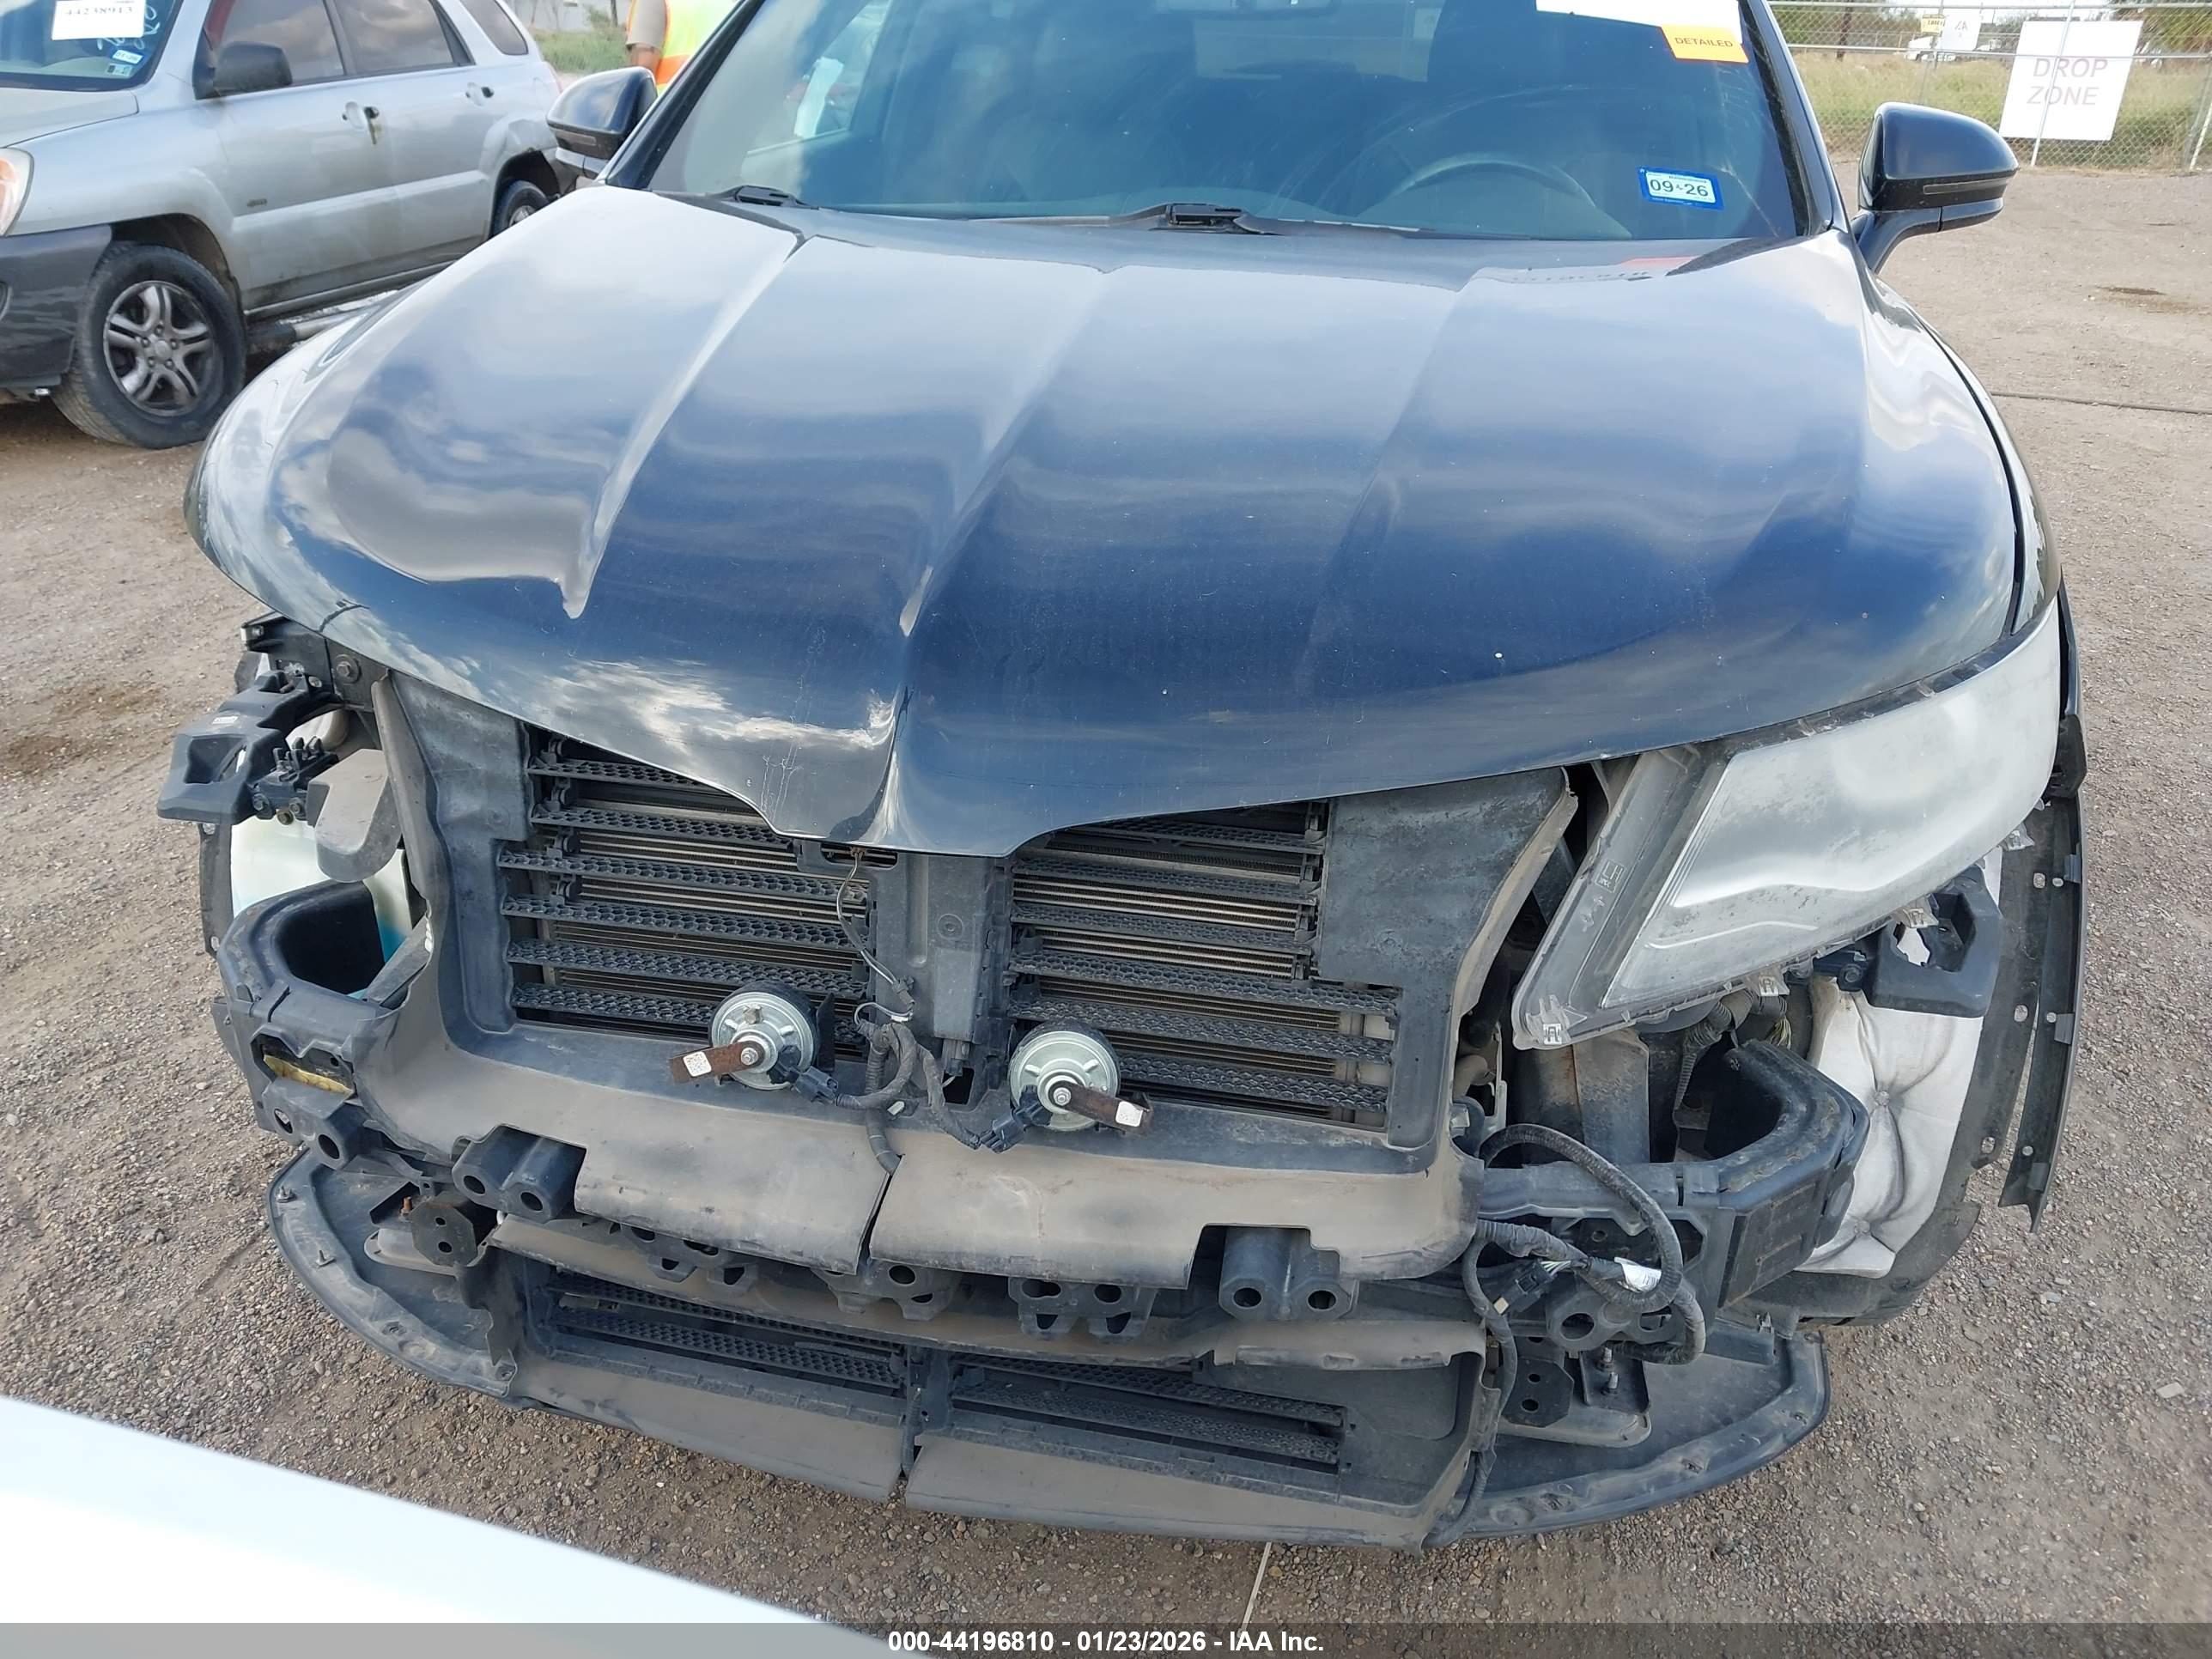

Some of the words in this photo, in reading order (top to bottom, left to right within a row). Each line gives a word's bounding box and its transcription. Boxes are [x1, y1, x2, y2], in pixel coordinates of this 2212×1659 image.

[1674, 37, 1734, 48] DETAILED
[2033, 58, 2108, 78] DROP
[2026, 85, 2100, 106] ZONE
[1650, 179, 1674, 193] 09
[1683, 183, 1709, 198] 26
